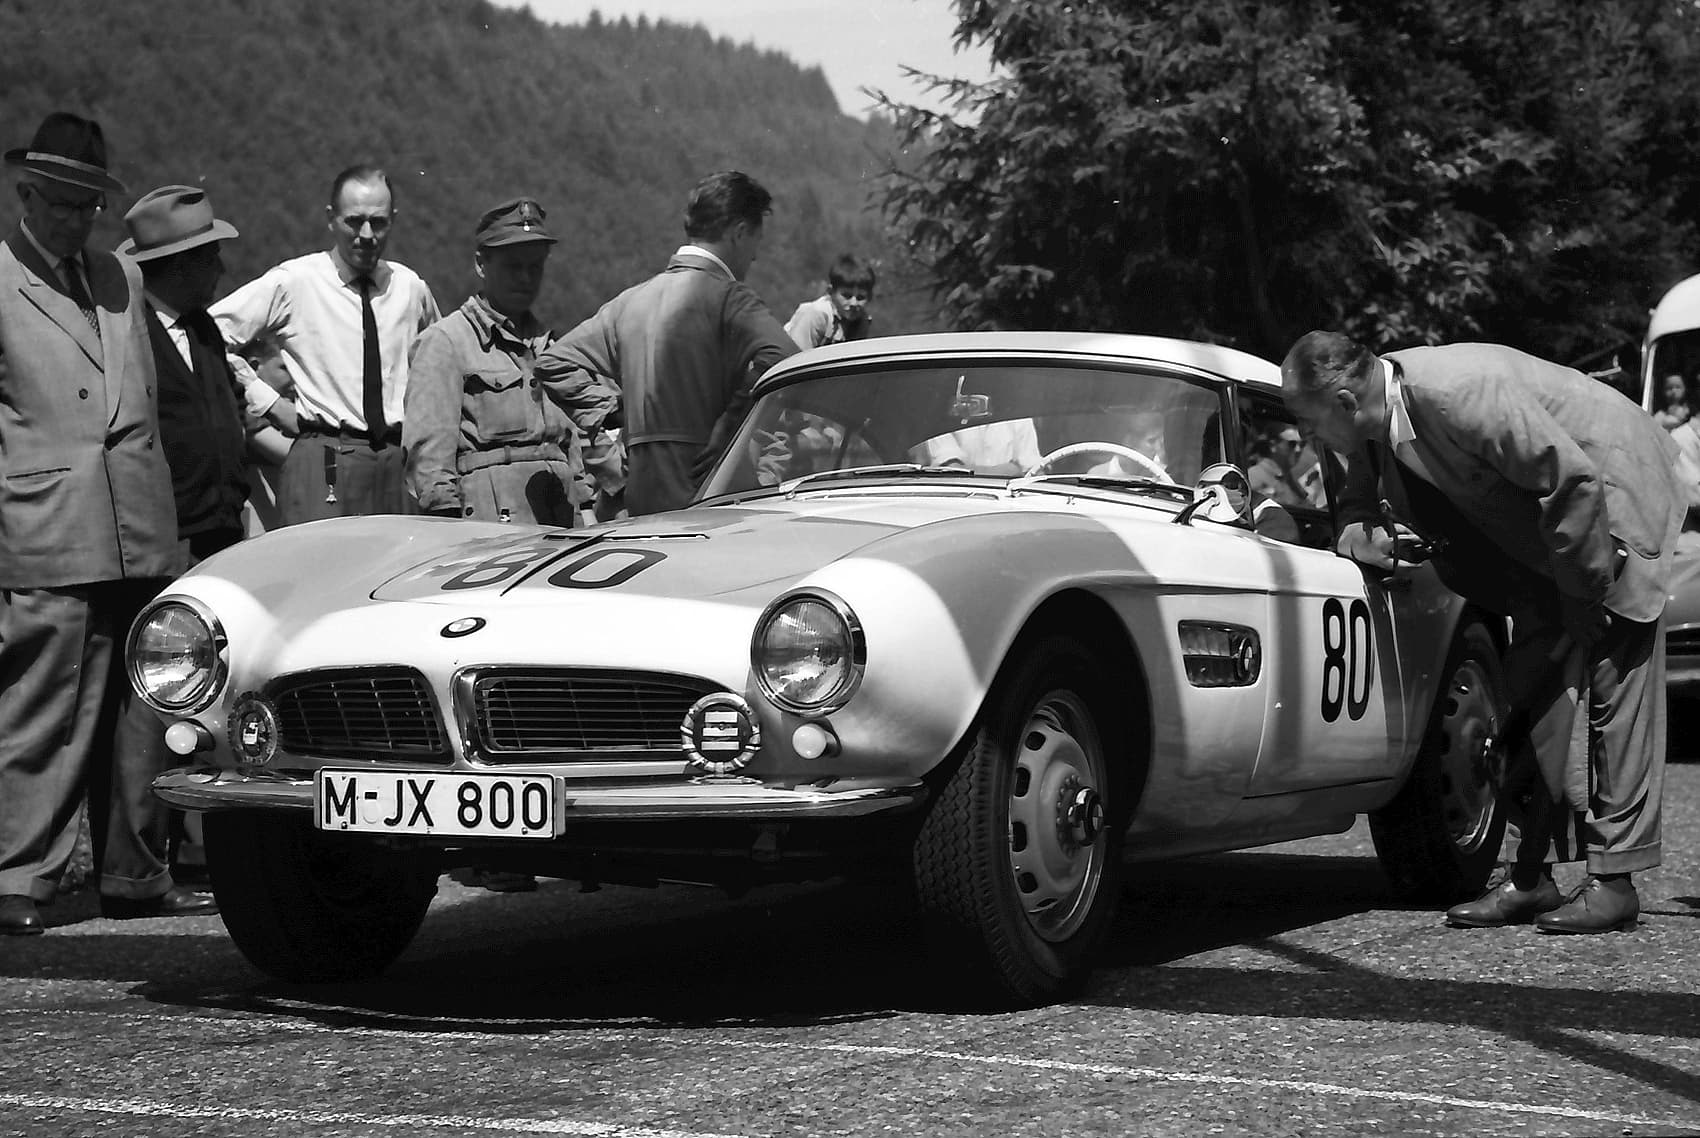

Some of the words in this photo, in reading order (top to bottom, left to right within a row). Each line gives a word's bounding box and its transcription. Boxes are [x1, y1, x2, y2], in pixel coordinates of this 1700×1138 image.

[440, 548, 668, 589] 80
[1321, 598, 1371, 723] 80
[457, 781, 548, 830] 800
